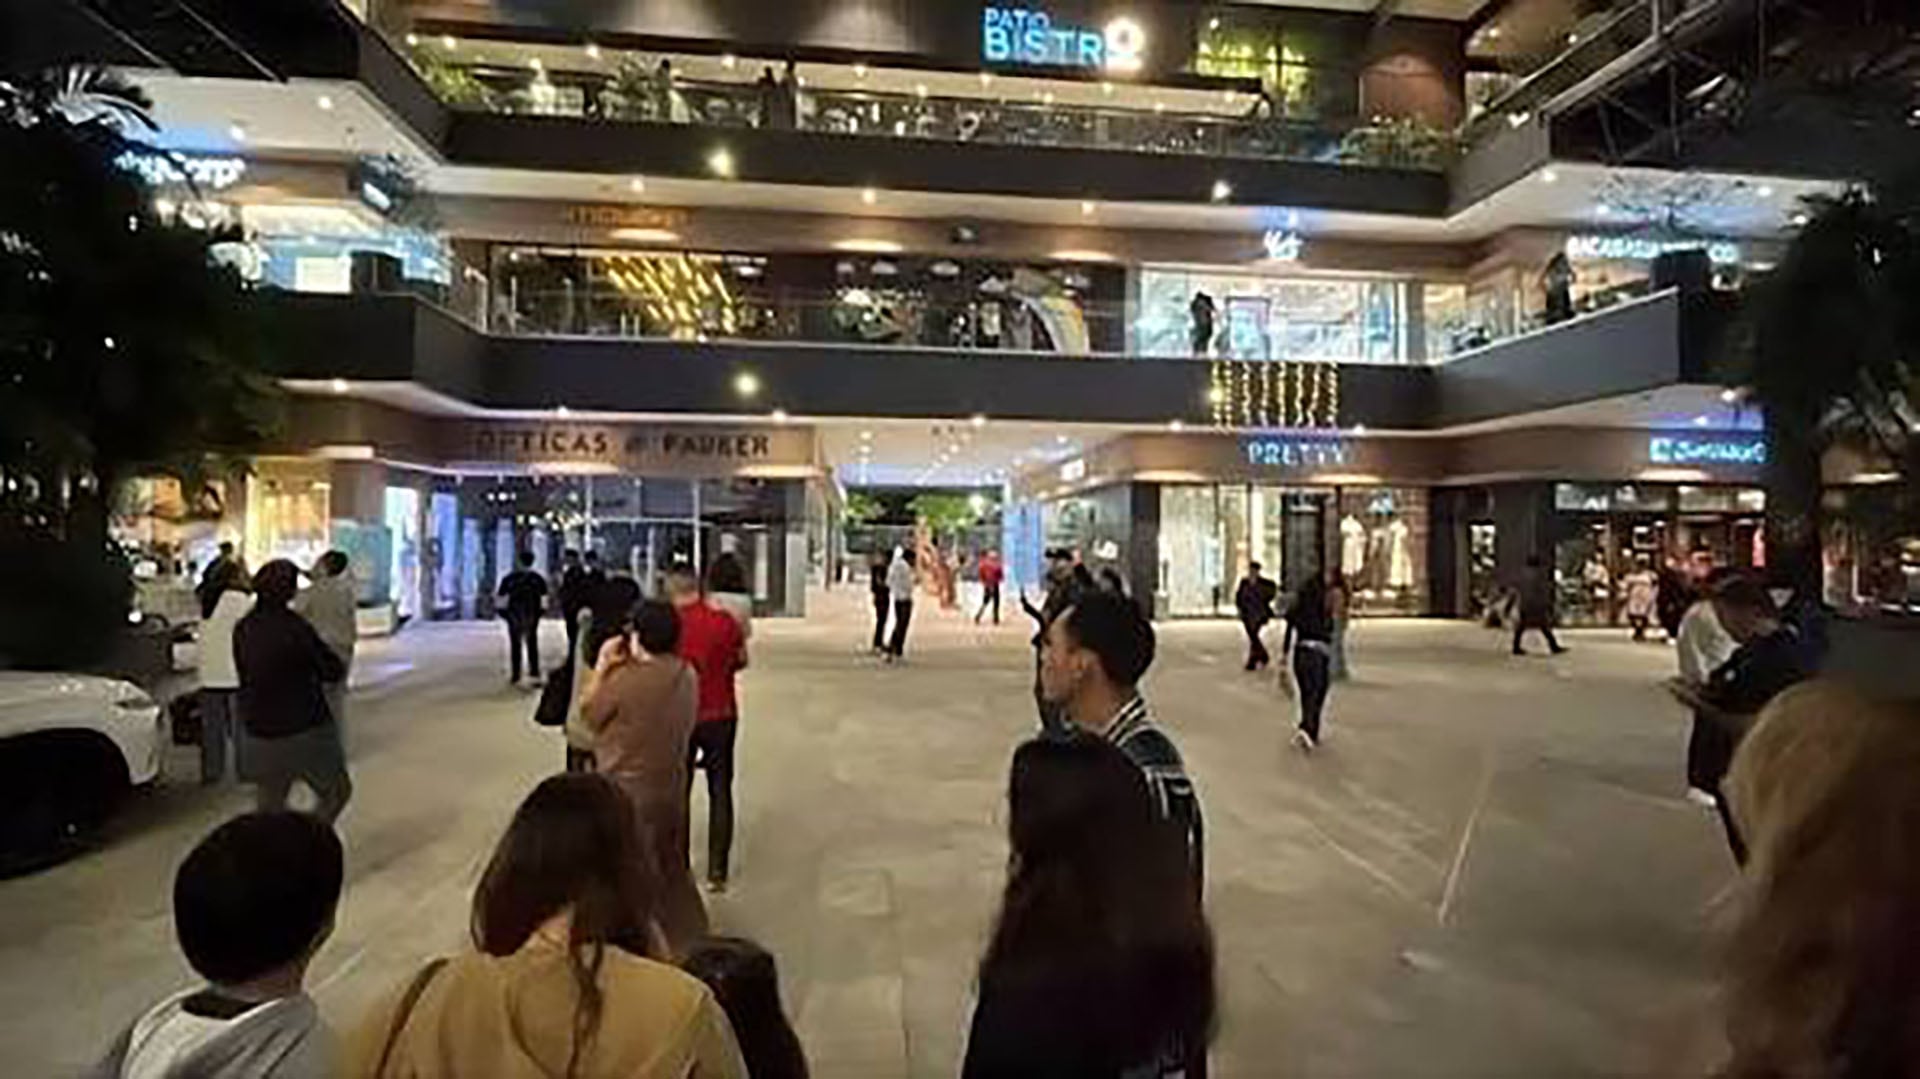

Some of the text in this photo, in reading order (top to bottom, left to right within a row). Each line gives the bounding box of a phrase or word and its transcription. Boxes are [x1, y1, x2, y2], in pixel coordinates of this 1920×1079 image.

[984, 8, 1050, 29] PATIO
[984, 17, 1146, 66] BISTRO
[1248, 442, 1350, 465] PRETTY
